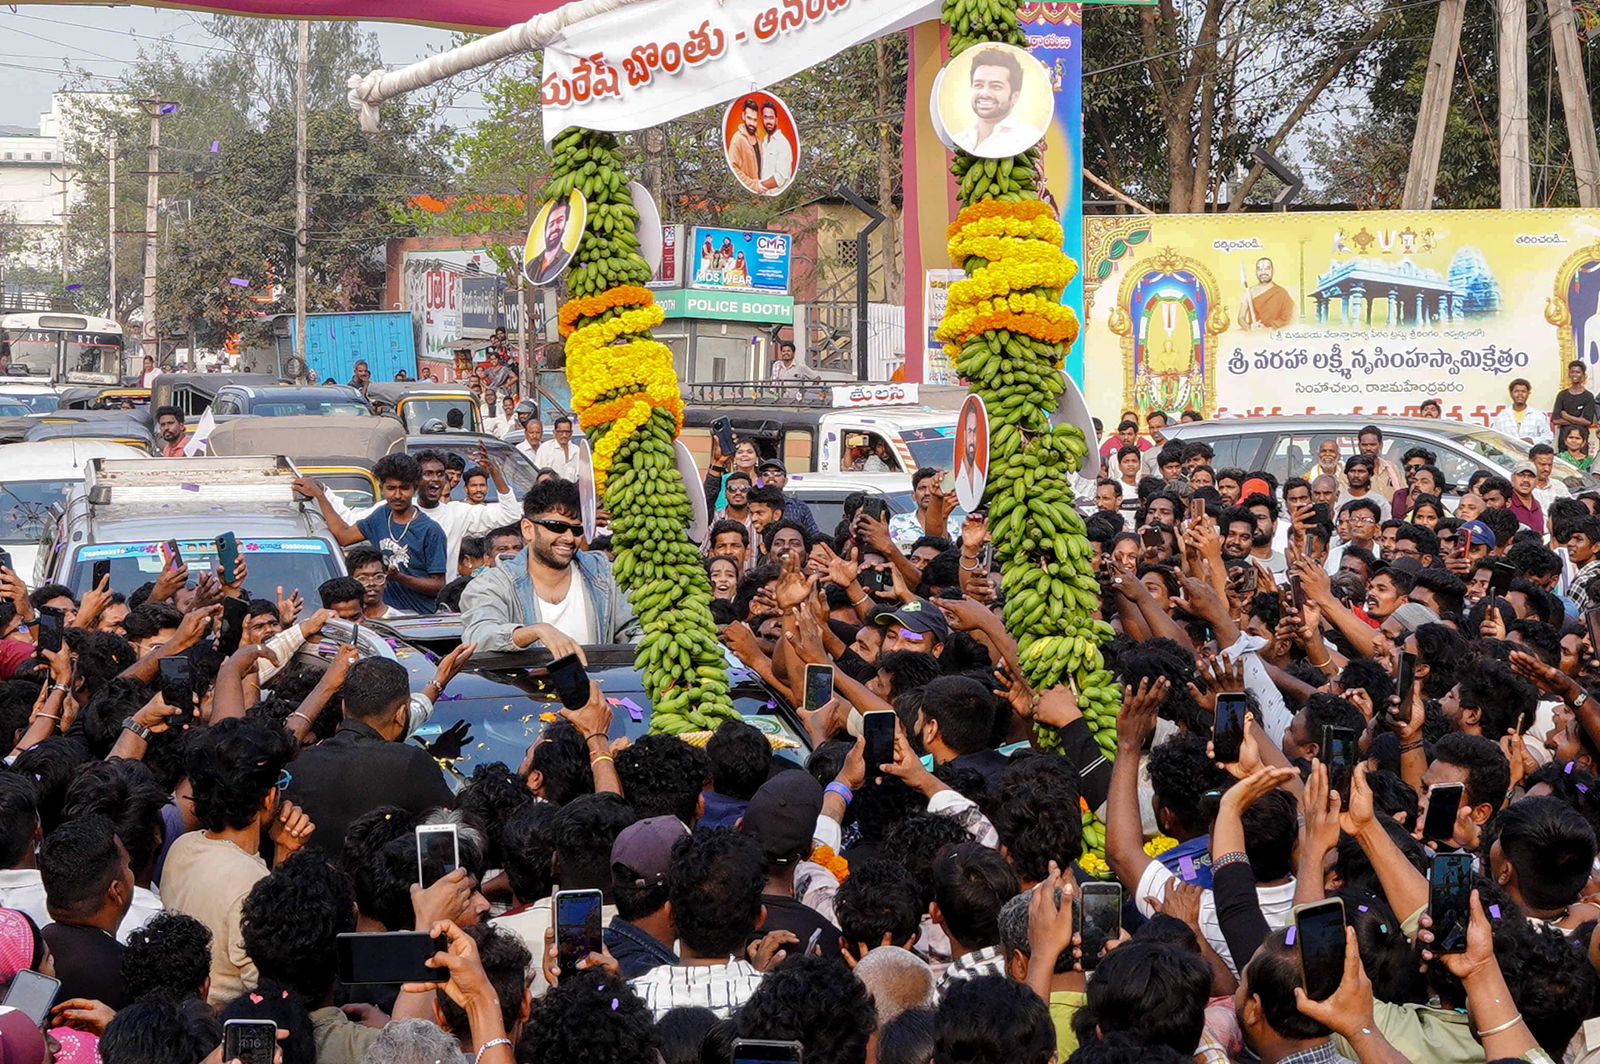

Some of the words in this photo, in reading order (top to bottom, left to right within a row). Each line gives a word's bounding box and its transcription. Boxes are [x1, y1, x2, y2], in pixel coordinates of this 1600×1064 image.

[622, 19, 725, 86] బొంతు
[758, 237, 786, 250] CMR
[696, 270, 720, 283] KIDS
[721, 271, 753, 286] WEAR
[687, 299, 738, 313] POLICE
[742, 302, 791, 316] BOOTH
[1228, 347, 1249, 375] శ్రీ
[1254, 348, 1309, 370] వరహా
[1365, 379, 1465, 396] రాజమహేంద్రవరం
